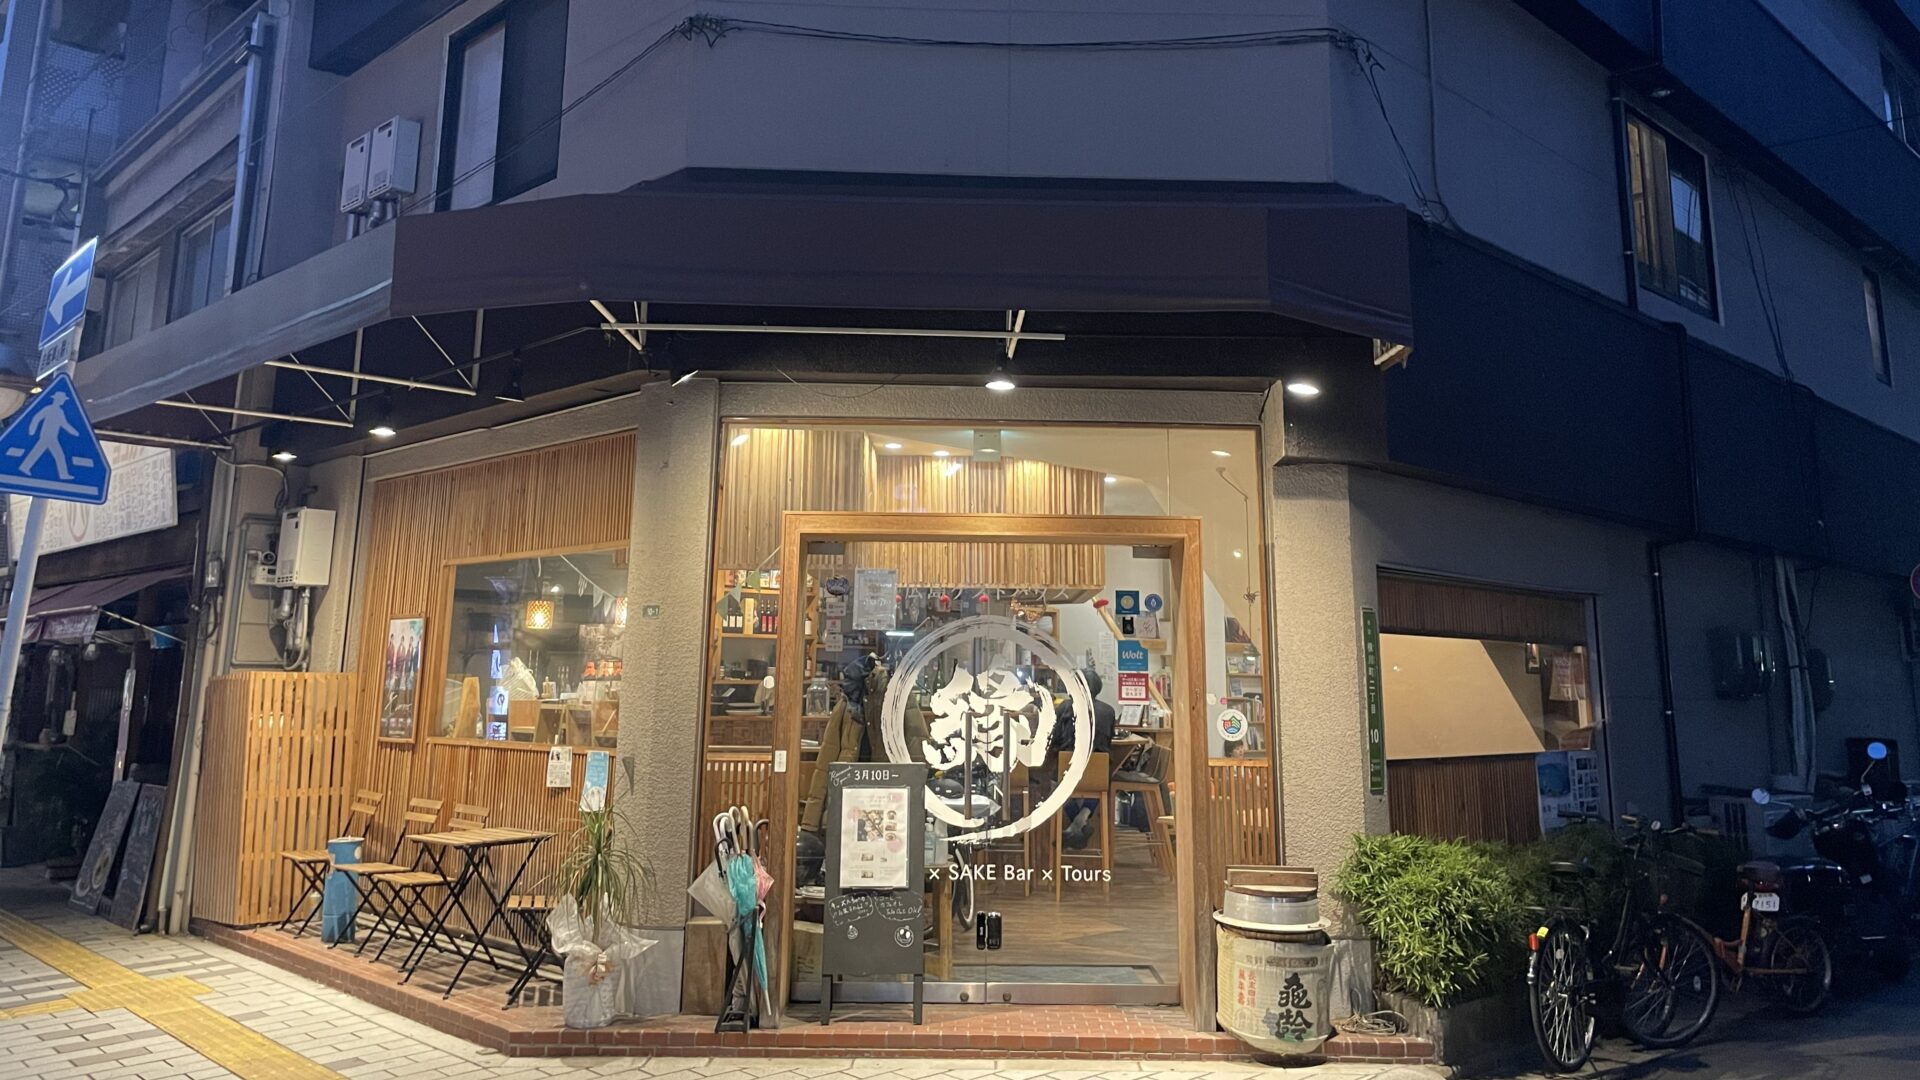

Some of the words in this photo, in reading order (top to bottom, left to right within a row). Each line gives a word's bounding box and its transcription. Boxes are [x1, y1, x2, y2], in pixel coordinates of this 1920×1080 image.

[1121, 650, 1145, 660] Wolt
[1370, 728, 1380, 744] 10
[948, 864, 997, 881] SAKE
[1003, 864, 1034, 881] Bar
[1060, 864, 1112, 882] Tours
